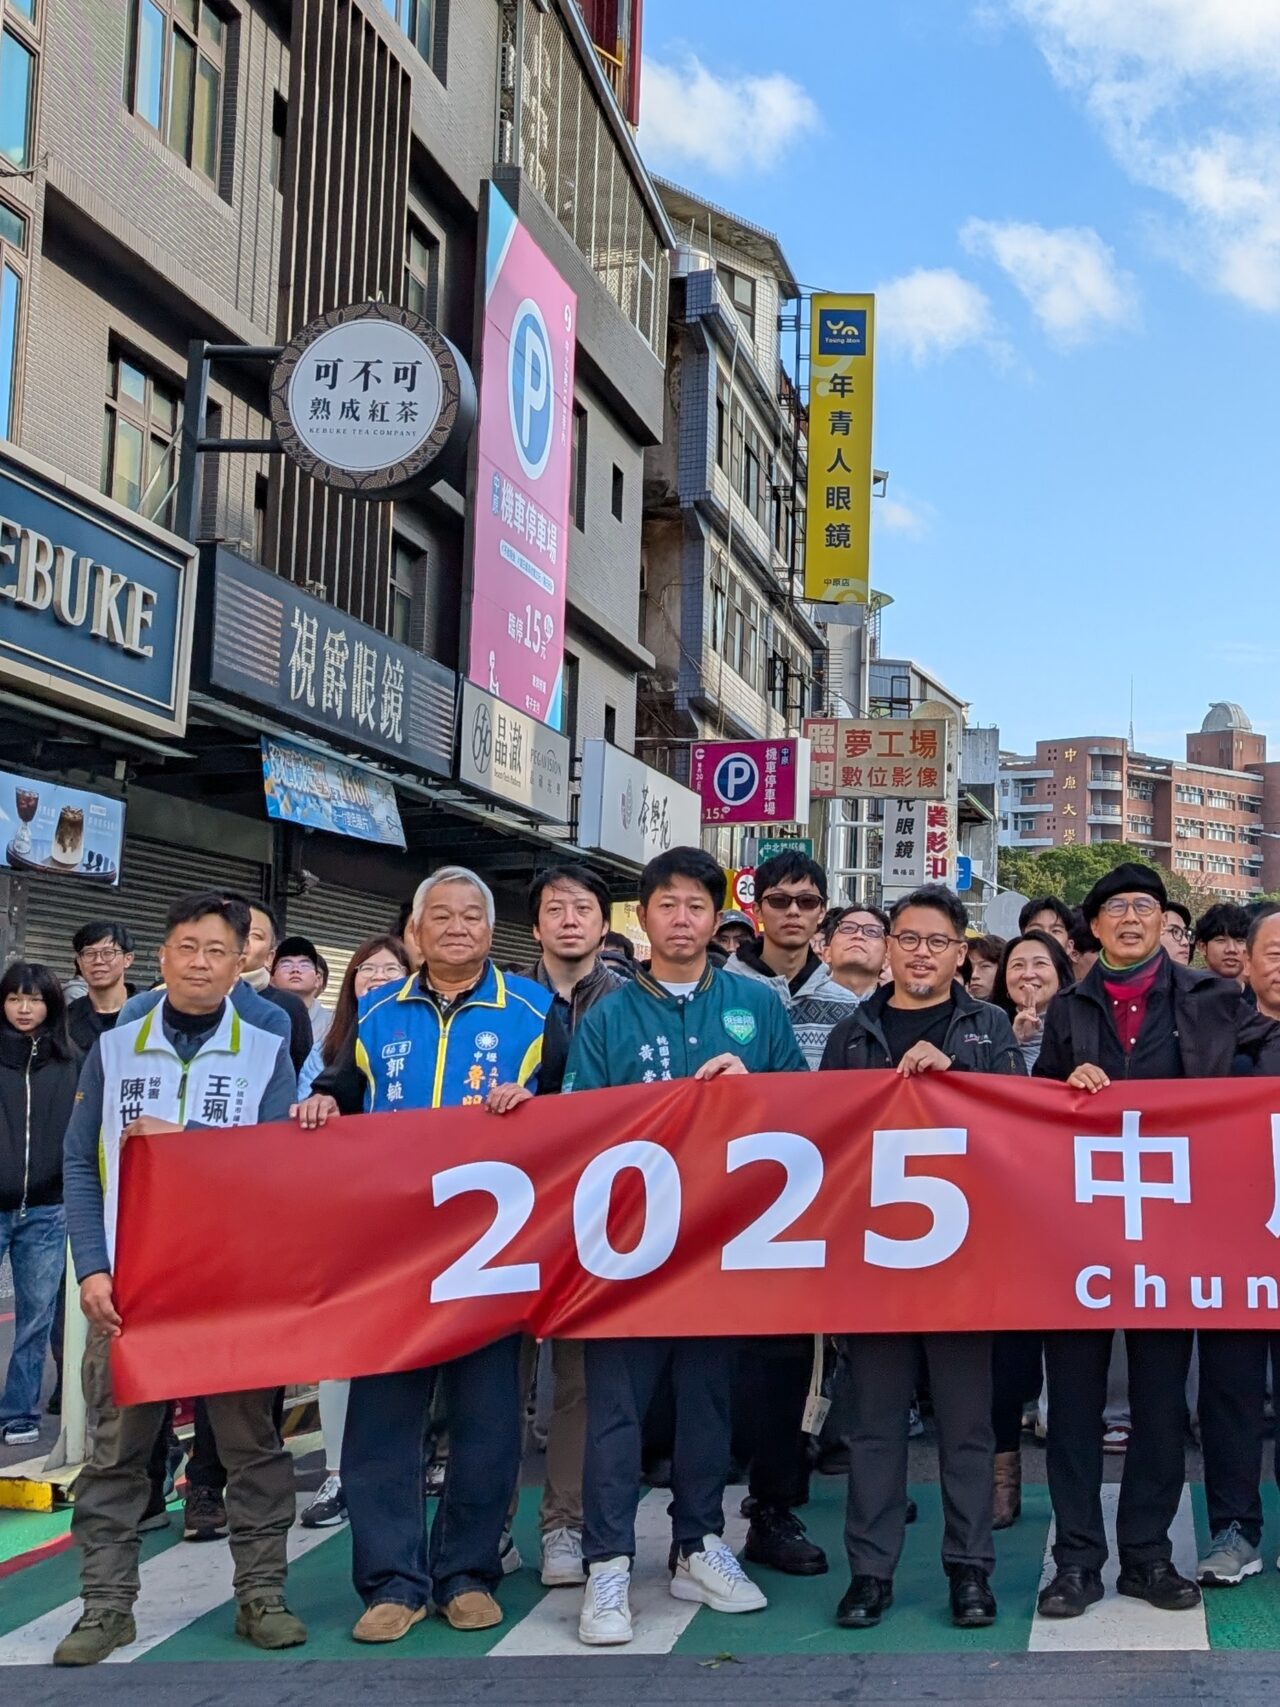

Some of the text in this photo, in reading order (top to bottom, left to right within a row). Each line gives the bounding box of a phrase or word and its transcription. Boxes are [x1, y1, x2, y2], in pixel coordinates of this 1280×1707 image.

[313, 357, 423, 393] 可不可
[308, 397, 418, 424] 熟成紅茶
[373, 429, 417, 437] COMPANY
[824, 373, 854, 549] 年青人眼鏡
[501, 479, 557, 565] 機車停車場
[824, 578, 850, 587] 中原店
[781, 748, 789, 765] 中原
[845, 729, 938, 759] 夢工場
[727, 761, 751, 799] P
[764, 747, 777, 815] 機車停車場
[842, 766, 938, 788] 數位影像
[1063, 748, 1077, 845] 中原大學
[739, 881, 755, 896] 20
[149, 1077, 161, 1099] 秘書
[386, 1057, 405, 1103] 郭毓
[120, 1078, 146, 1137] 陳世
[202, 1074, 231, 1124] 王珮
[430, 1128, 970, 1303] 2025
